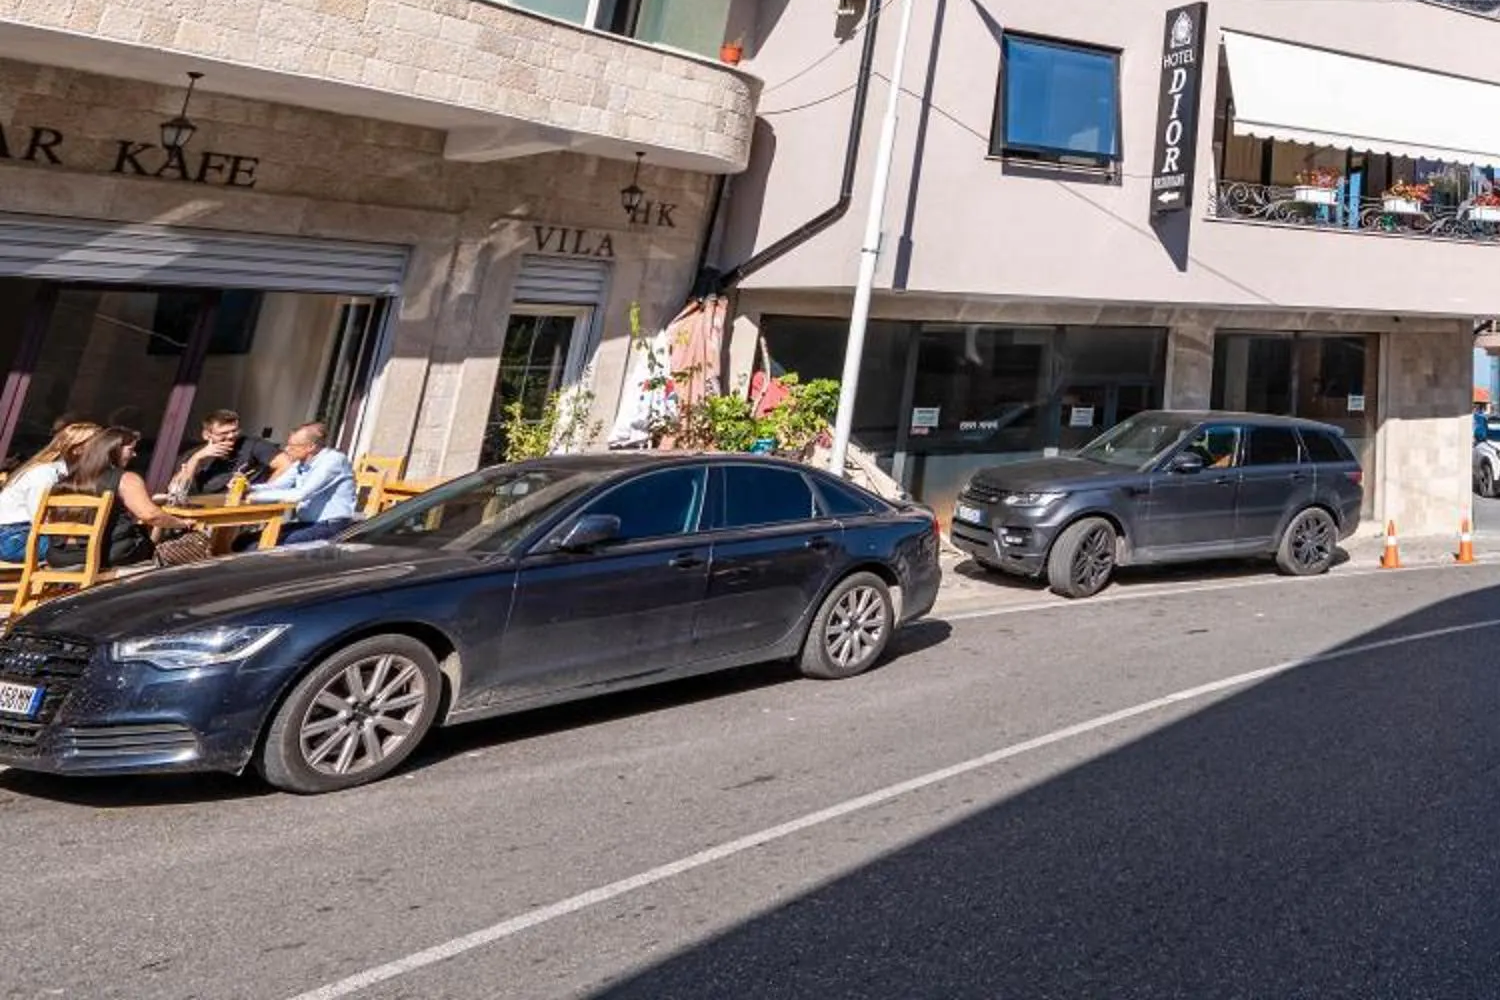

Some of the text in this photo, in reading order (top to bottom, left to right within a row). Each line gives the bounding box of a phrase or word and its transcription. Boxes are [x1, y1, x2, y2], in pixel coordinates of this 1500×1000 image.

[1162, 49, 1194, 69] HOTEL
[1161, 67, 1187, 173] DIOR
[111, 140, 260, 188] KAFE
[533, 201, 679, 257] VILA HK
